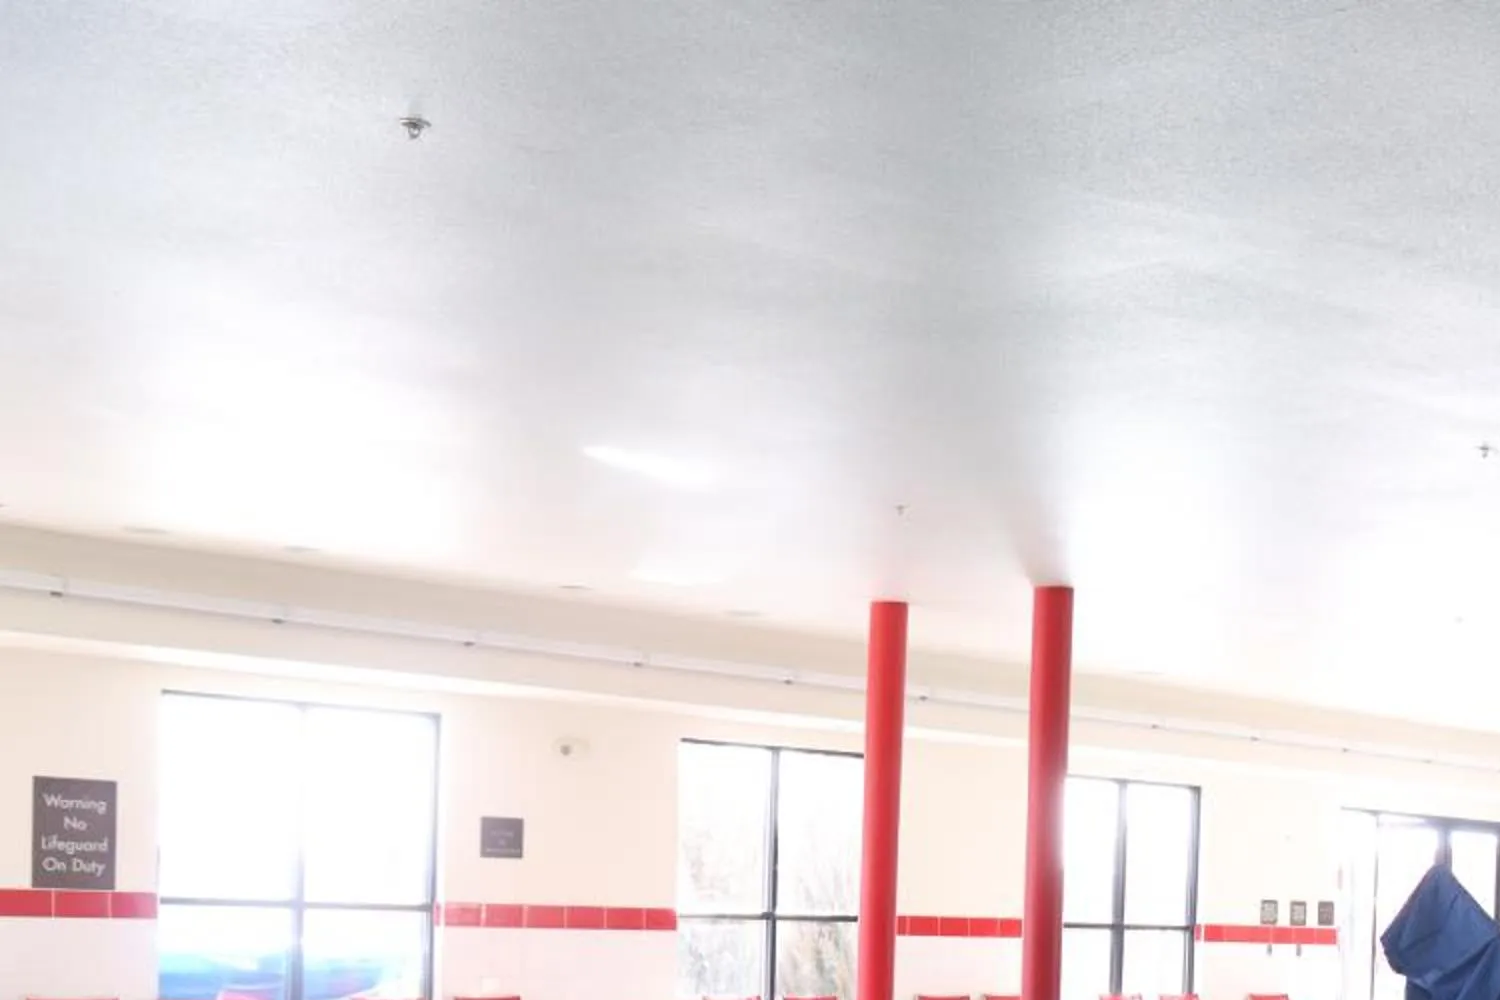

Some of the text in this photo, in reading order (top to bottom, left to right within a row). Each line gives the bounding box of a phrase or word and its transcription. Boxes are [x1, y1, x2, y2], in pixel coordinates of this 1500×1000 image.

[42, 793, 107, 815] Warning
[63, 816, 88, 831] No
[41, 834, 109, 855] Lifeguard
[42, 857, 106, 877] On Duty
